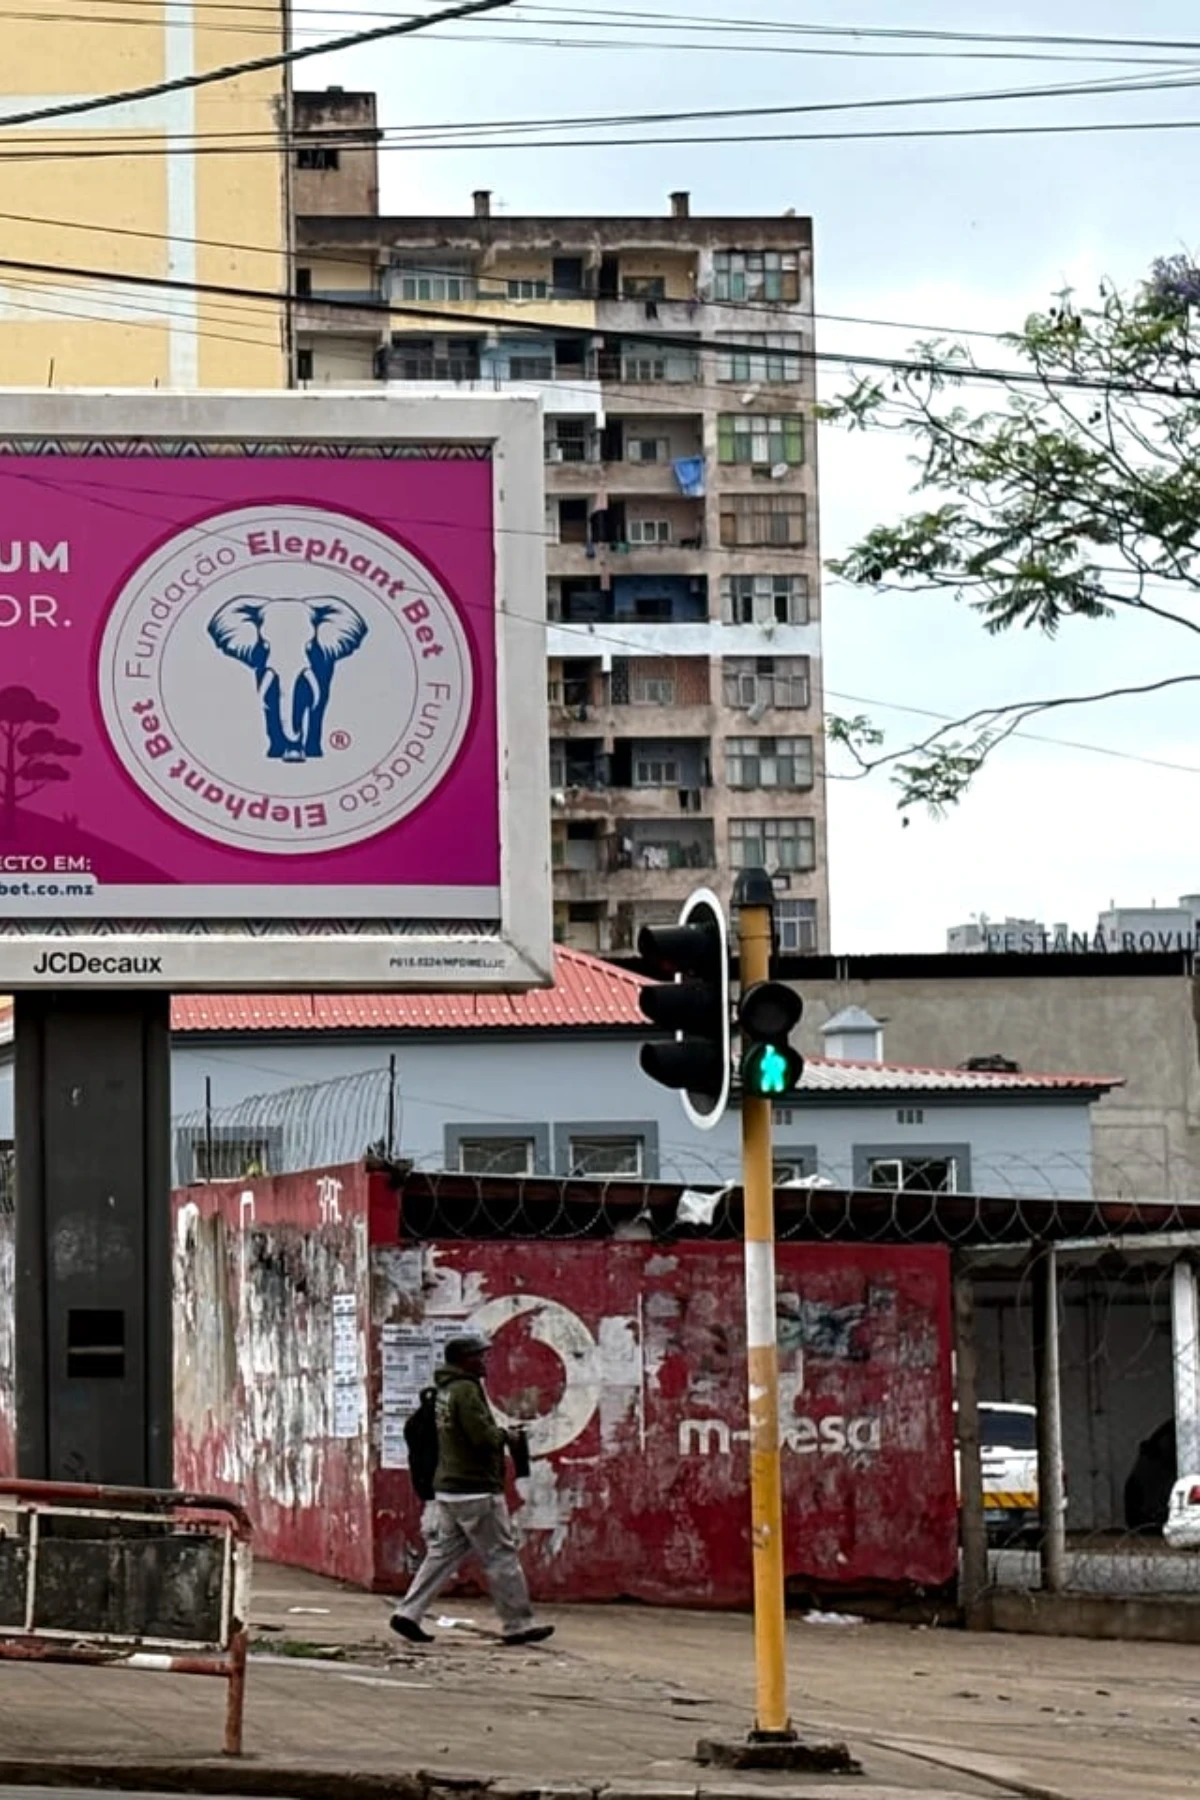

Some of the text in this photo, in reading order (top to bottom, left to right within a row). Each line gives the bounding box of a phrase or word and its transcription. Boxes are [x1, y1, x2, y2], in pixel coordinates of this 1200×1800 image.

[125, 529, 444, 680] Fundação Elephant Bet
[132, 680, 451, 829] Fundação Elephant Bet
[53, 856, 92, 871] EM:
[33, 951, 162, 974] JCDecaux
